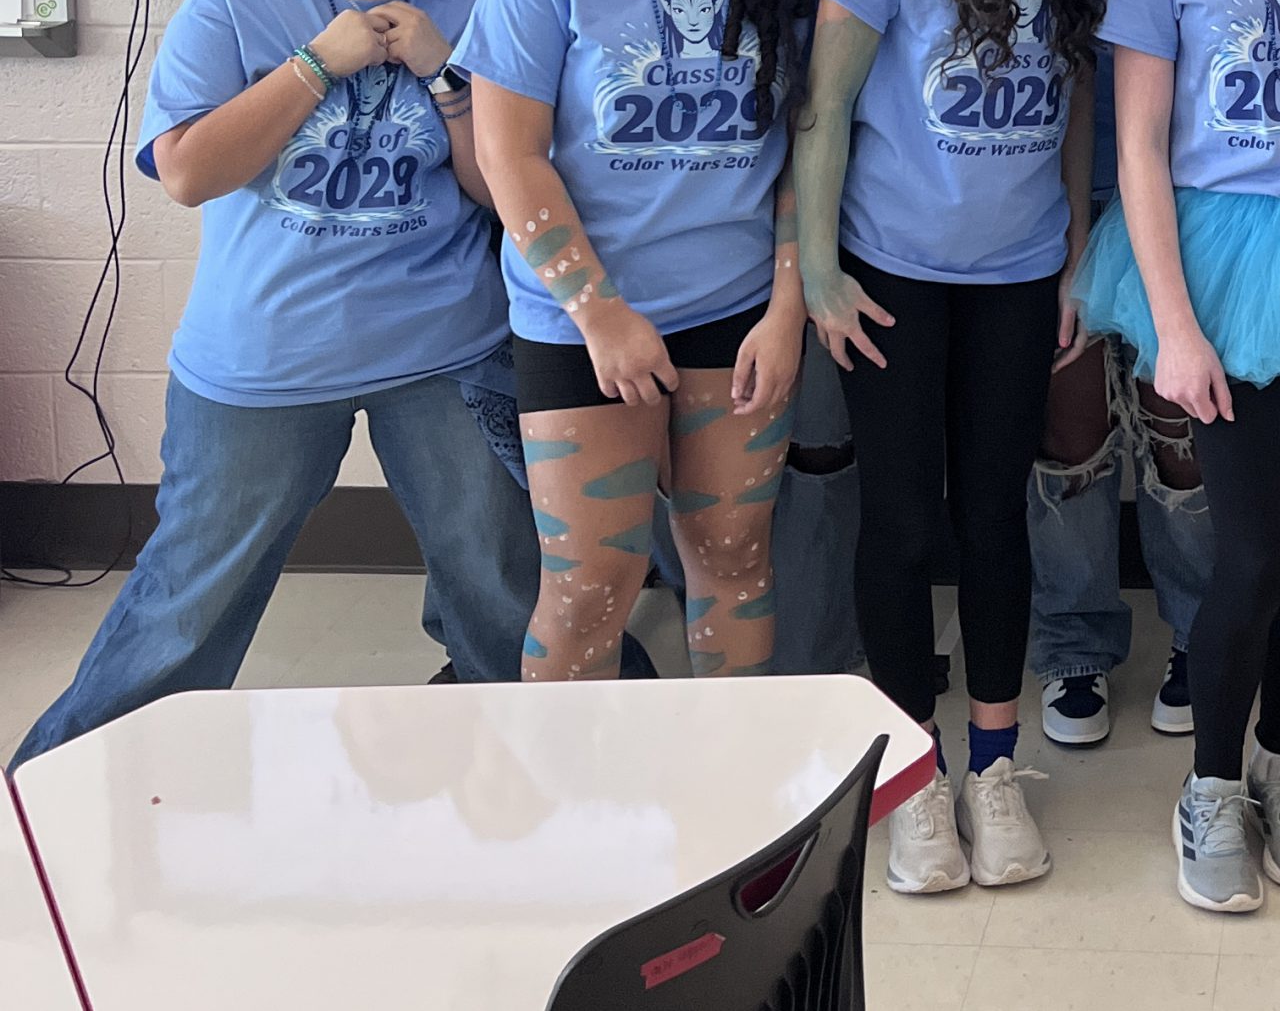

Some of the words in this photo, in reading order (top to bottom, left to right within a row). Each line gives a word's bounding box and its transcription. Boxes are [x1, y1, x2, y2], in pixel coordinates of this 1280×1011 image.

[647, 64, 716, 86] Class
[724, 59, 753, 86] of
[1037, 54, 1057, 74] of
[940, 73, 1062, 129] 2029
[611, 89, 775, 143] 2029
[379, 127, 408, 153] of
[936, 139, 986, 156] Color
[991, 143, 1027, 156] Wars
[1029, 138, 1058, 153] 2026
[1228, 135, 1275, 150] Color
[609, 157, 664, 171] Color
[671, 158, 721, 171] Wars
[288, 154, 418, 209] 2029
[280, 216, 327, 237] Color
[331, 224, 382, 237] Wars
[386, 215, 428, 235] 2026
